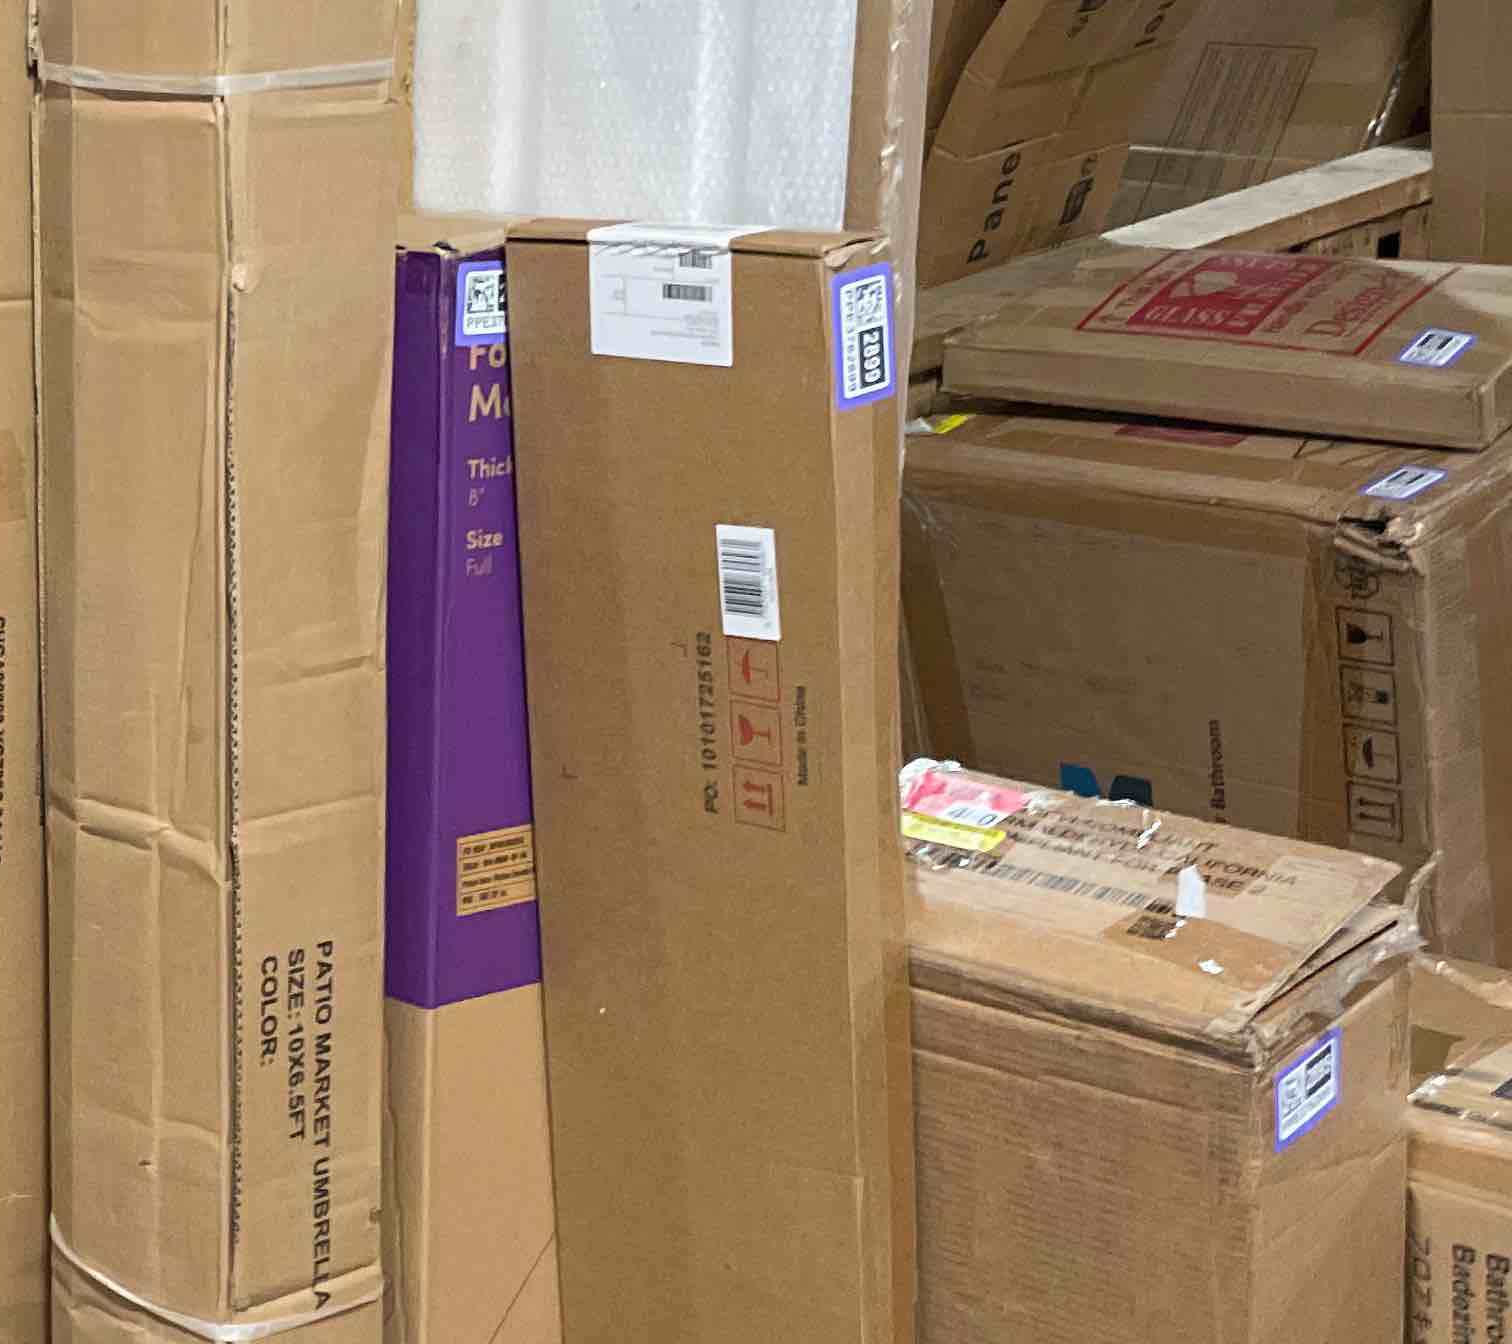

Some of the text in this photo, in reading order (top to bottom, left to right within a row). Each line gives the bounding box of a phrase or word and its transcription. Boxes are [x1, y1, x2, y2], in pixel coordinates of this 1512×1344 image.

[465, 556, 492, 578] Full
[466, 530, 504, 551] Size
[259, 956, 279, 1068] COLOR:
[311, 940, 333, 1311] PATIO MARKET UMBRELLA
